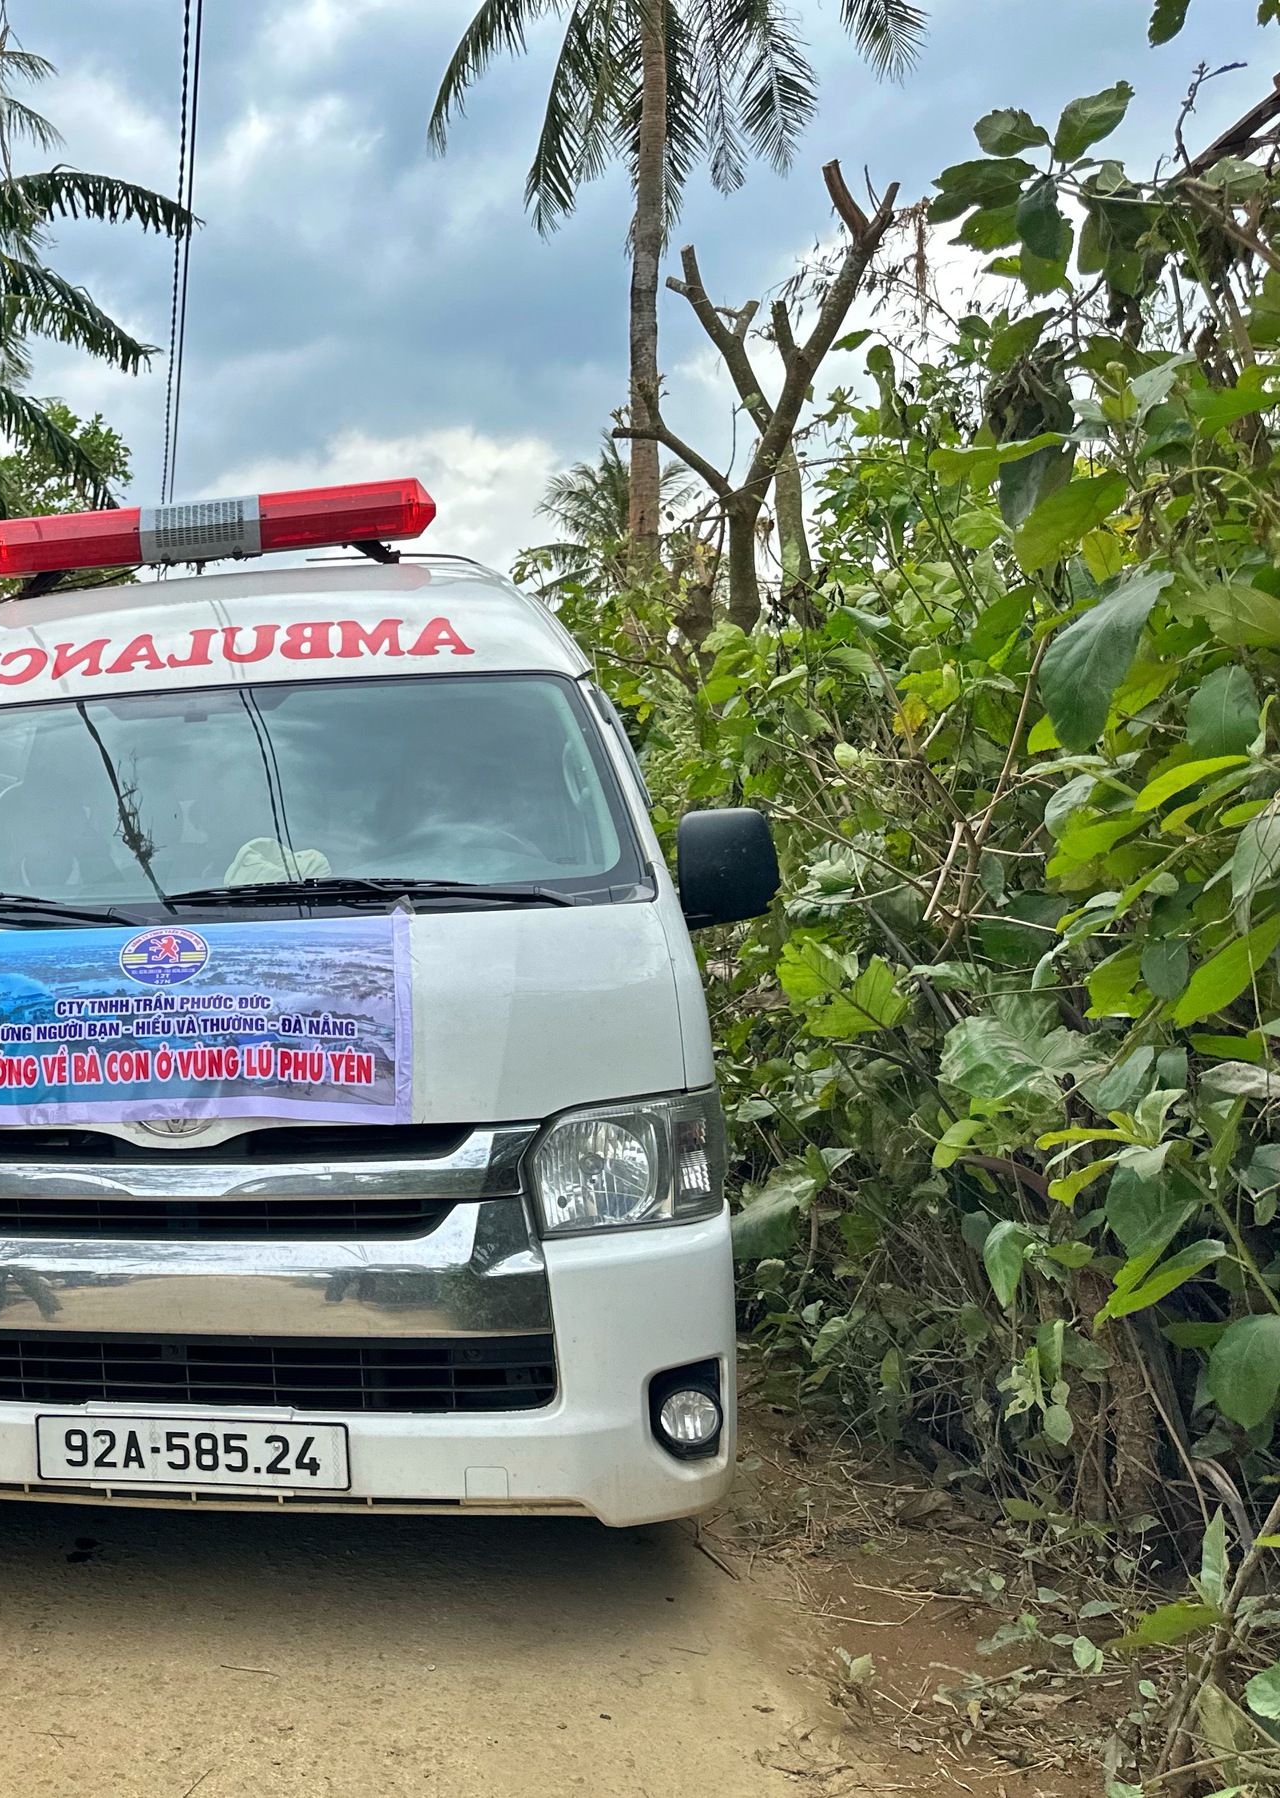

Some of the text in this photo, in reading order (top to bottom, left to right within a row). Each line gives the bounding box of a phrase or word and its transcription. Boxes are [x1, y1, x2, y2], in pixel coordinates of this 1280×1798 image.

[57, 993, 271, 1015] CTY TNHH TRẦN PHƯỚC ĐỨC
[36, 1022, 83, 1040] NGƯỜI
[88, 1022, 120, 1041] BẠN
[135, 1015, 171, 1035] HIỂU
[176, 1017, 197, 1034] VÀ
[281, 1015, 304, 1034] ĐÀ
[308, 1014, 355, 1037] NẴNG
[42, 1047, 67, 1084] VỀ
[73, 1049, 101, 1083] BÀ
[106, 1052, 149, 1083] CON
[156, 1044, 174, 1080] Ở
[178, 1045, 239, 1079] VÙNG
[246, 1046, 272, 1078] LŨ
[280, 1046, 324, 1082] PHÚ
[330, 1049, 372, 1084] YÊN
[65, 1428, 322, 1477] 92A-585.24
